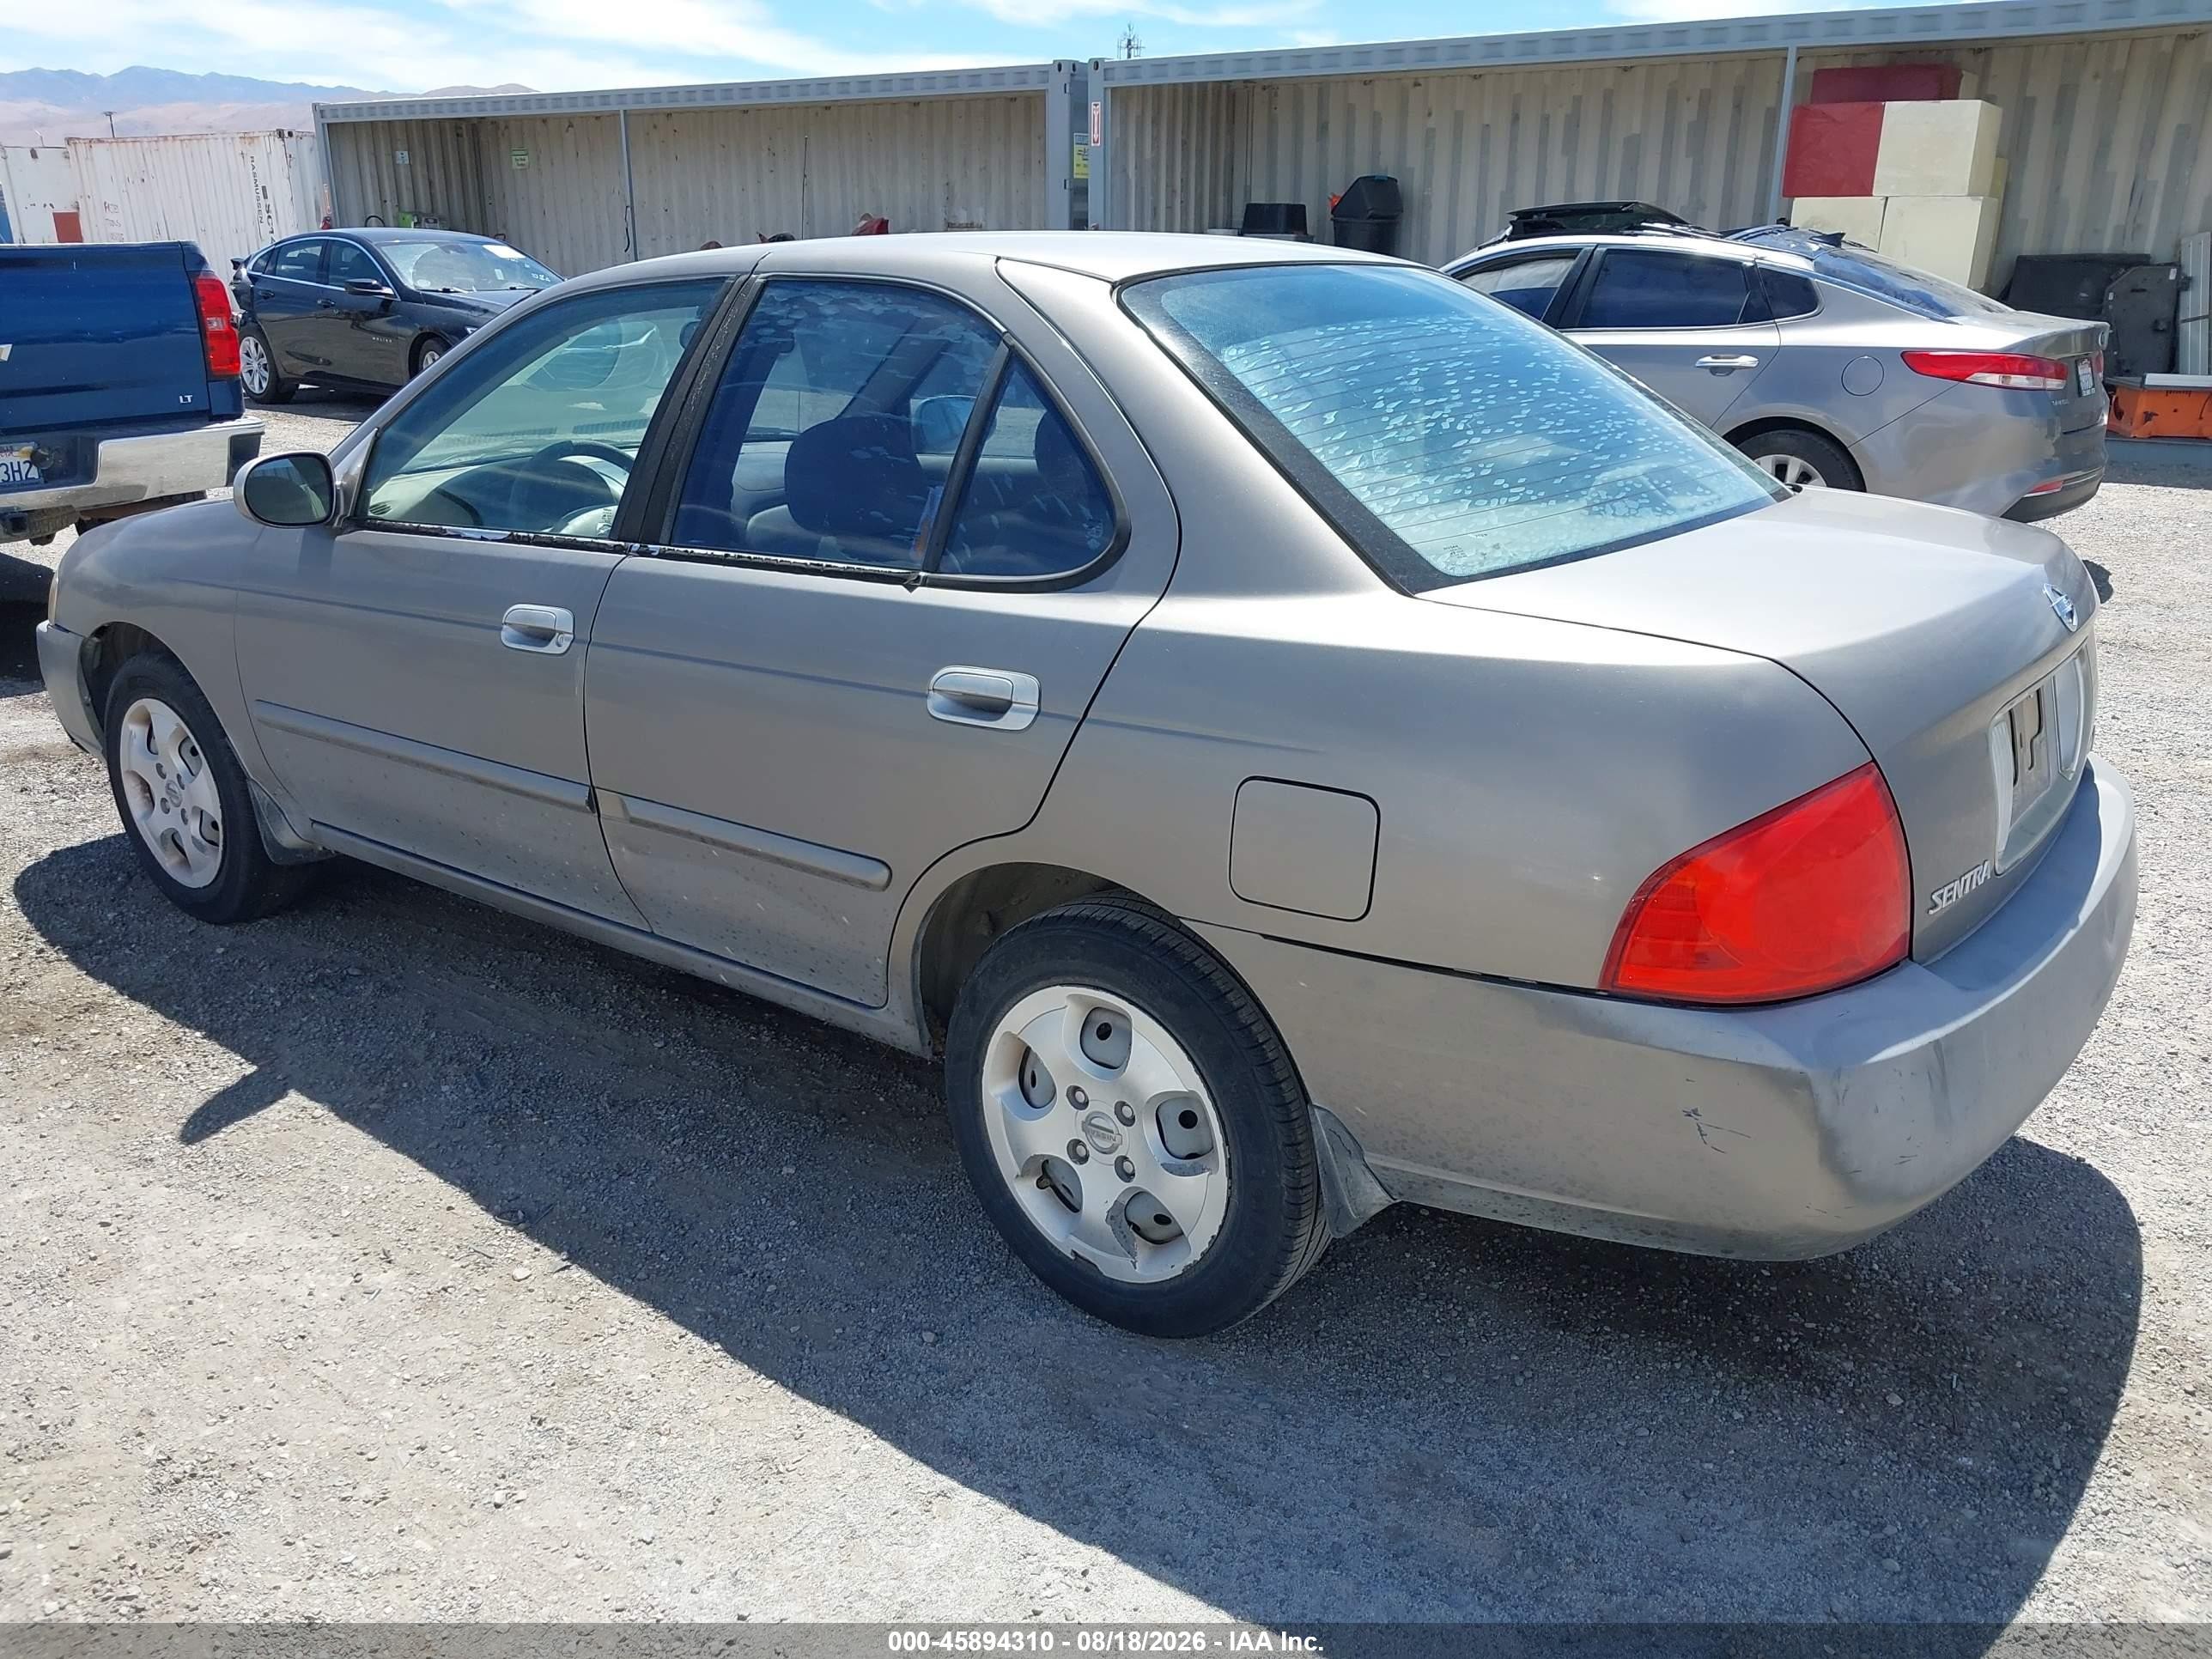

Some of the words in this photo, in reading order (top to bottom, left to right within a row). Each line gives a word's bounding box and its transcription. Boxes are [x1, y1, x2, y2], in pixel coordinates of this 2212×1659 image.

[250, 155, 264, 224] RASMUSSEN
[179, 394, 193, 404] LT
[0, 460, 41, 483] 3H2
[1929, 860, 1991, 915] SENTRA
